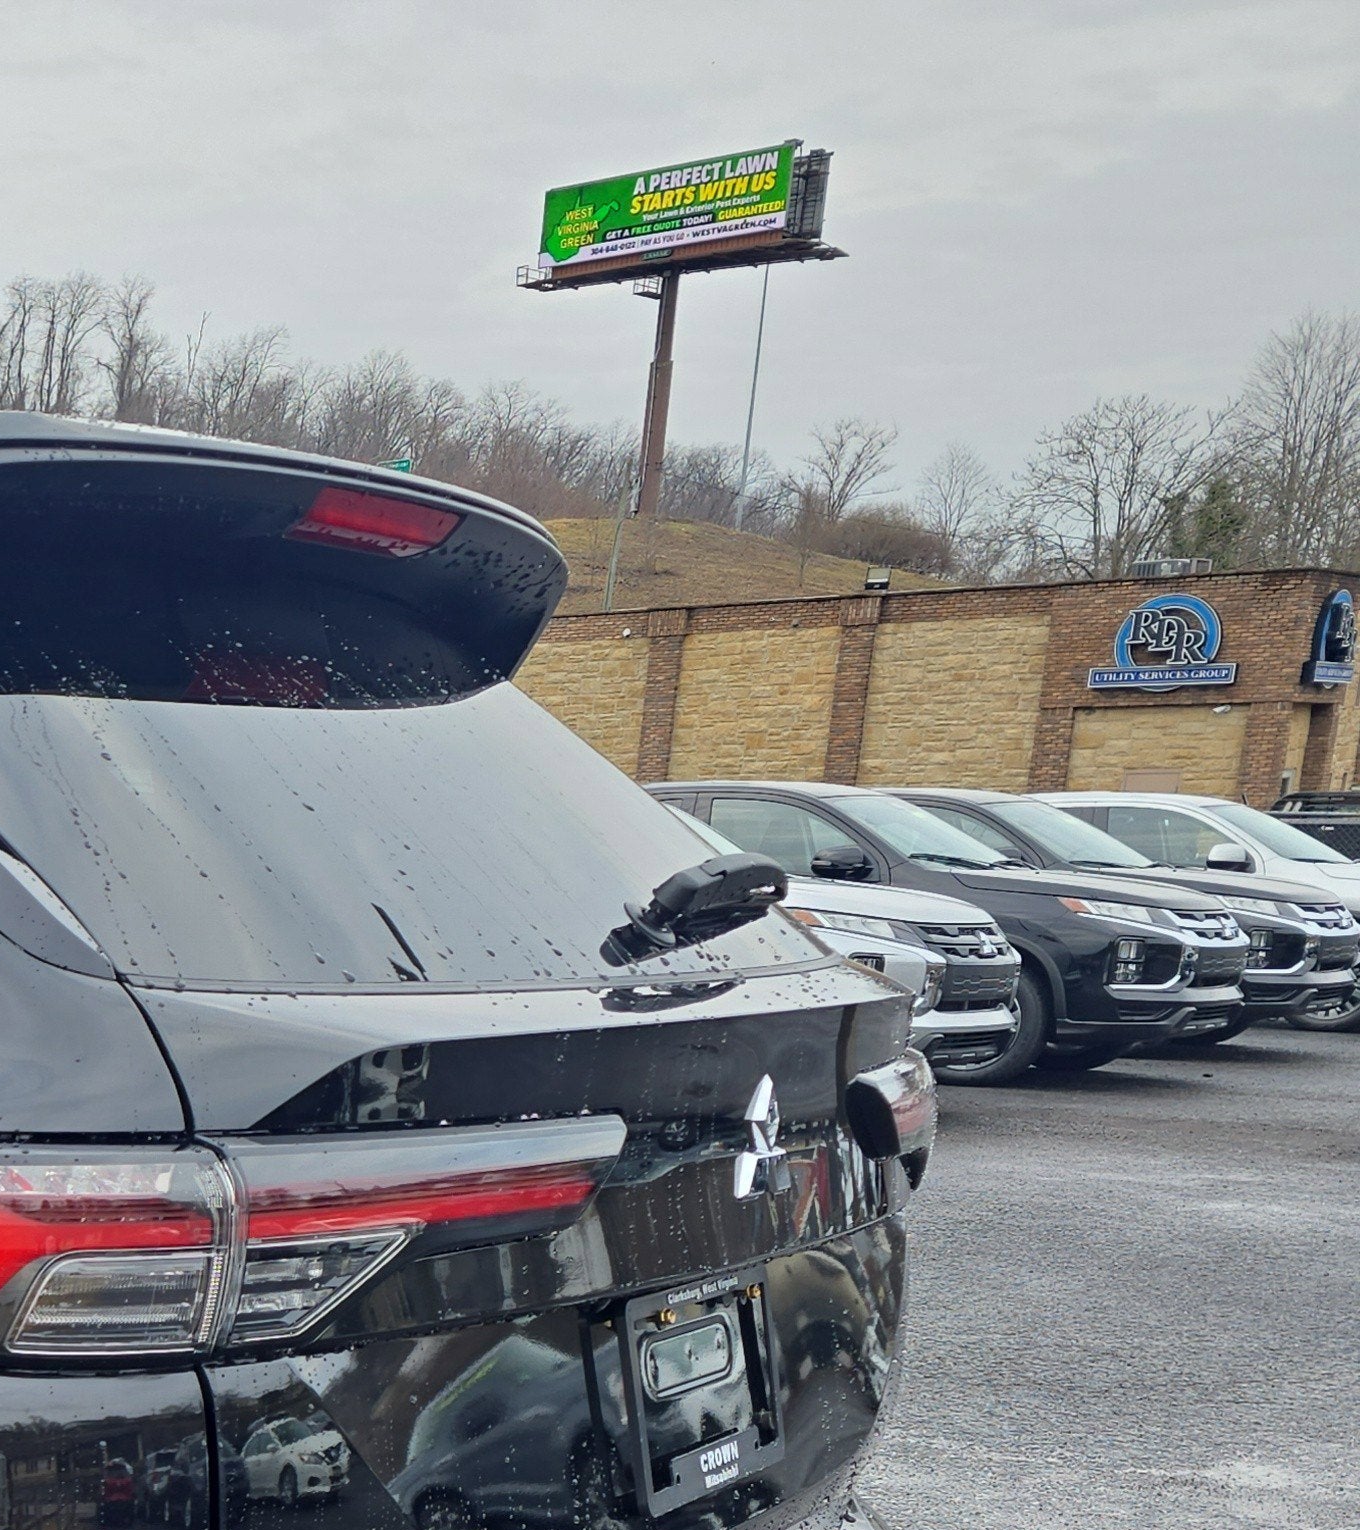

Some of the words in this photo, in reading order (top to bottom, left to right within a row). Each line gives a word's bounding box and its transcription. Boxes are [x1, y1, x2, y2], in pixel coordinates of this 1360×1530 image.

[633, 176, 646, 195] A
[648, 161, 723, 190] PERFECT
[725, 151, 779, 176] LAWN
[630, 186, 696, 214] STARTS
[698, 176, 749, 201] WITH
[751, 171, 777, 193] US
[565, 205, 594, 221] WEST
[642, 212, 659, 222] Your
[660, 209, 679, 219] Lawn
[685, 203, 715, 214] Exterior
[715, 199, 731, 209] Pest
[732, 194, 761, 206] Experts
[718, 200, 786, 220] GUARANTEED!
[557, 220, 599, 236] VIRGINIA
[606, 228, 622, 240] GET
[622, 226, 630, 236] A
[630, 223, 652, 235] FREE
[653, 218, 681, 232] QUOTE
[682, 213, 713, 227] TODAY!
[560, 233, 594, 248] GREEN
[653, 234, 662, 245] AS
[1125, 608, 1208, 665] RDR
[1094, 671, 1137, 682] UTILITY
[1138, 669, 1189, 681] SERVICES
[1190, 668, 1229, 679] GROUP
[700, 1440, 739, 1473] CROWN
